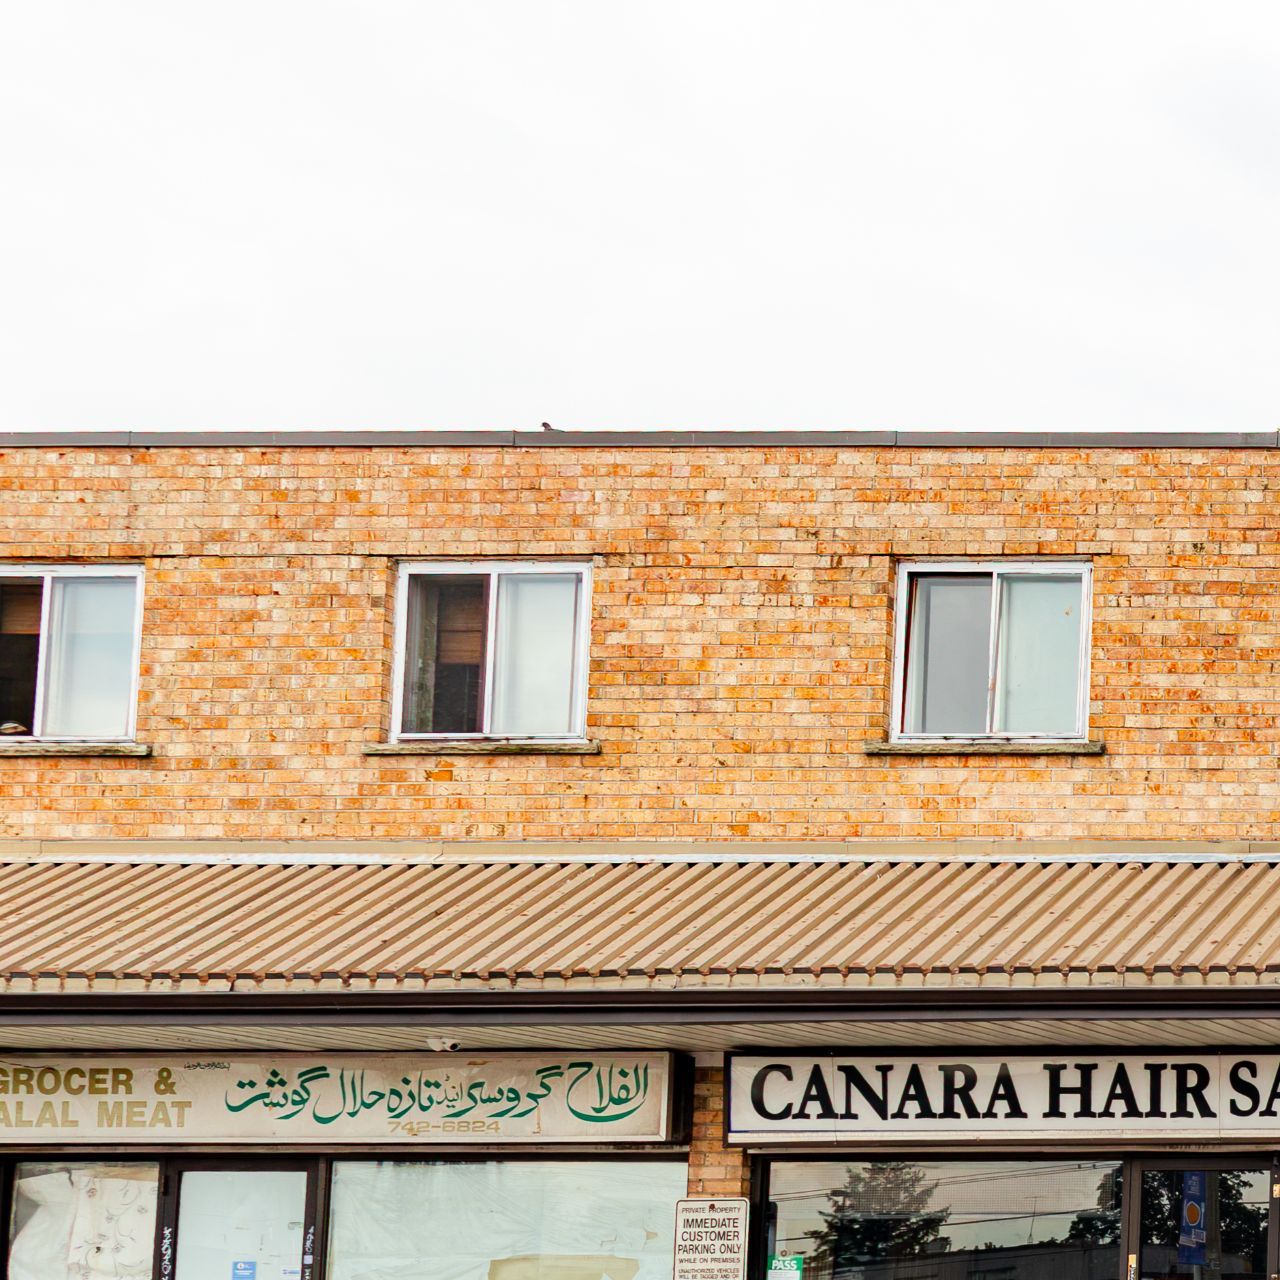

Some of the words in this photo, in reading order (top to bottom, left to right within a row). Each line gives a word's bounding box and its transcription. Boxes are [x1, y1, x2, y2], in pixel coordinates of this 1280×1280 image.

[153, 1067, 177, 1096] &
[566, 1061, 649, 1123] الفلاح
[750, 1062, 1028, 1121] CANARA
[1042, 1062, 1217, 1119] HAIR
[97, 1101, 193, 1128] MEAT
[387, 1120, 501, 1133] 742-6824
[683, 1218, 739, 1228] IMMEDIATE
[681, 1231, 740, 1241] CUSTOMER
[678, 1244, 716, 1254] PARKING
[719, 1244, 742, 1254] ONLY
[771, 1260, 797, 1270] PASS
